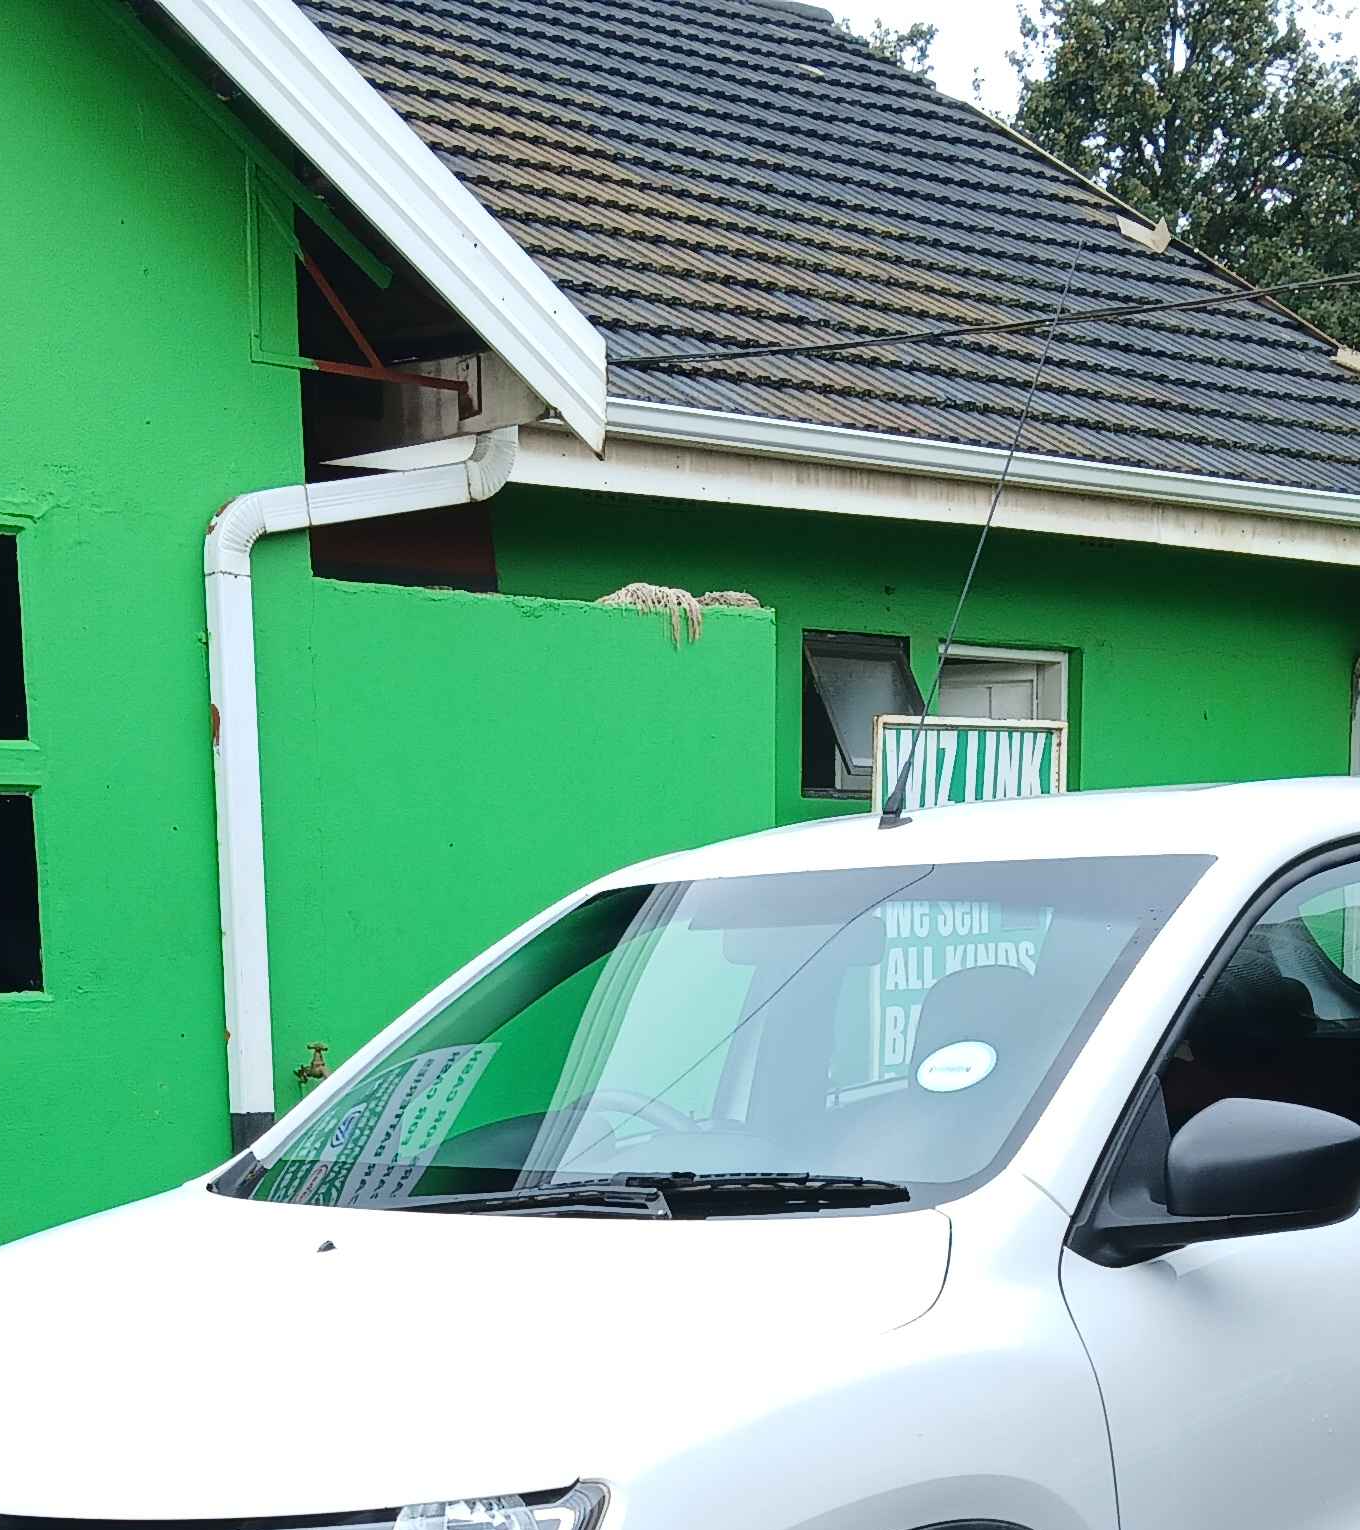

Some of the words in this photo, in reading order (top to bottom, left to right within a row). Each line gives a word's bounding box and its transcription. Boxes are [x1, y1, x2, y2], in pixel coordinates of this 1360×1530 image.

[885, 729, 957, 810] WIZ
[964, 731, 1047, 803] LINK
[886, 946, 937, 990] ALL
[945, 941, 1036, 976] KINDS
